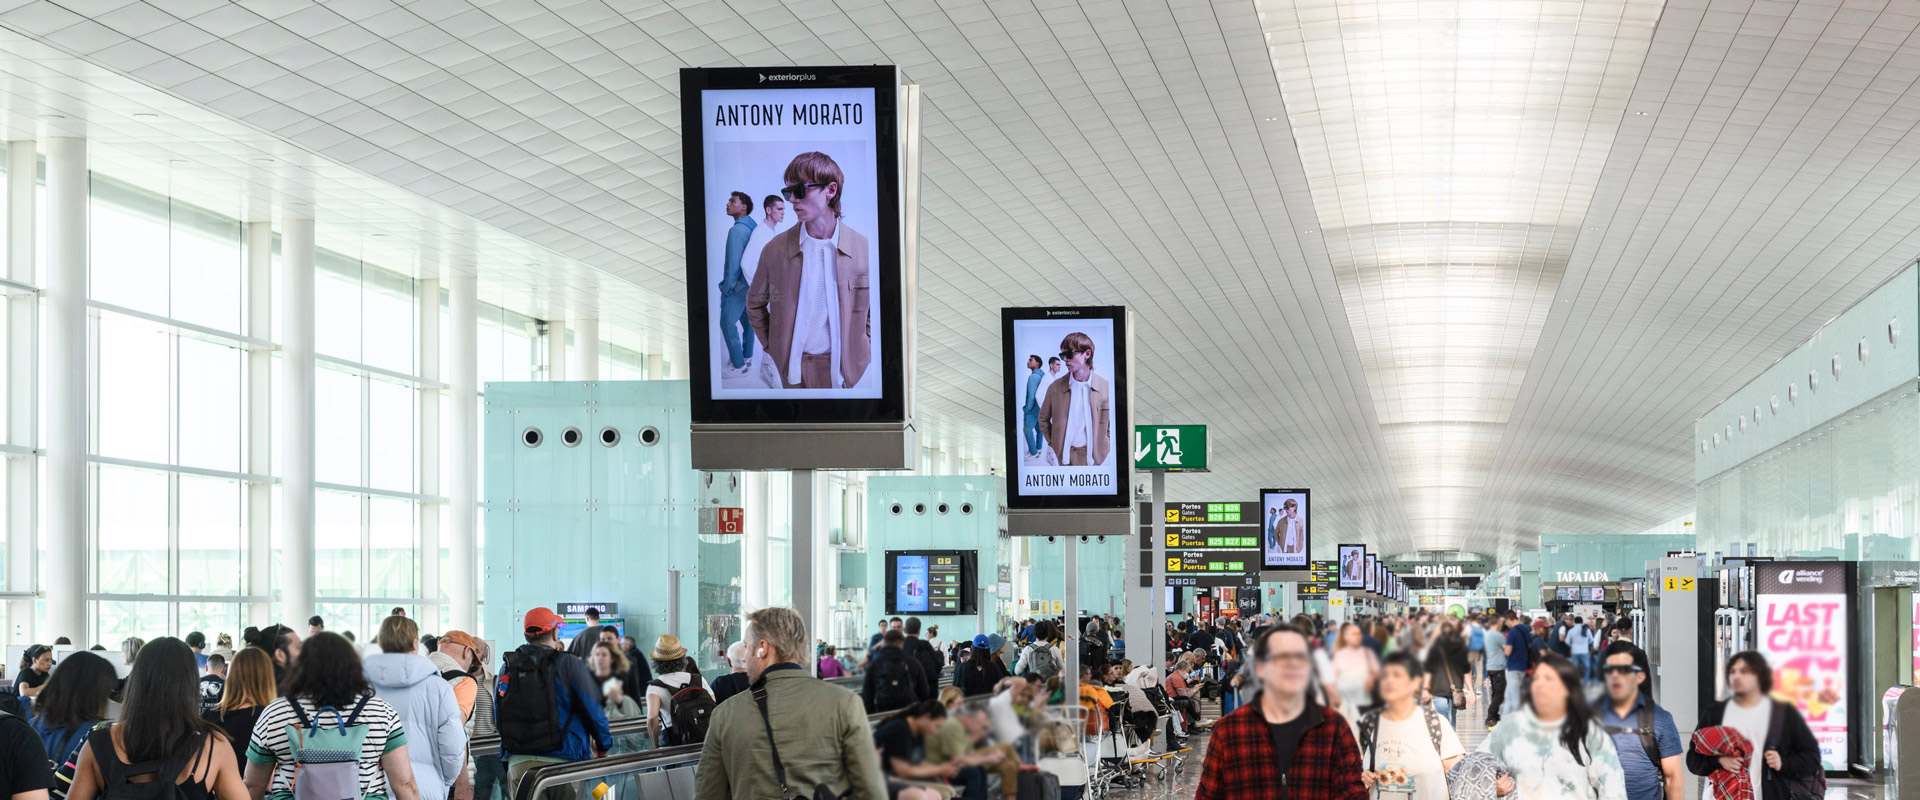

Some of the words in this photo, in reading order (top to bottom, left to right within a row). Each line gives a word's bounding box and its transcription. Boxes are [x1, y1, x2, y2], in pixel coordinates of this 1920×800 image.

[768, 73, 816, 82] exteriorplus
[715, 104, 784, 126] ANTONY
[793, 103, 863, 125] MORATO
[1025, 474, 1065, 487] ANTONY
[1069, 473, 1110, 487] MORATO
[1556, 571, 1582, 582] TAPA
[1584, 571, 1609, 582] TAPA
[1795, 576, 1823, 584] vending
[1765, 603, 1840, 626] LAST
[1767, 629, 1837, 652] CALL
